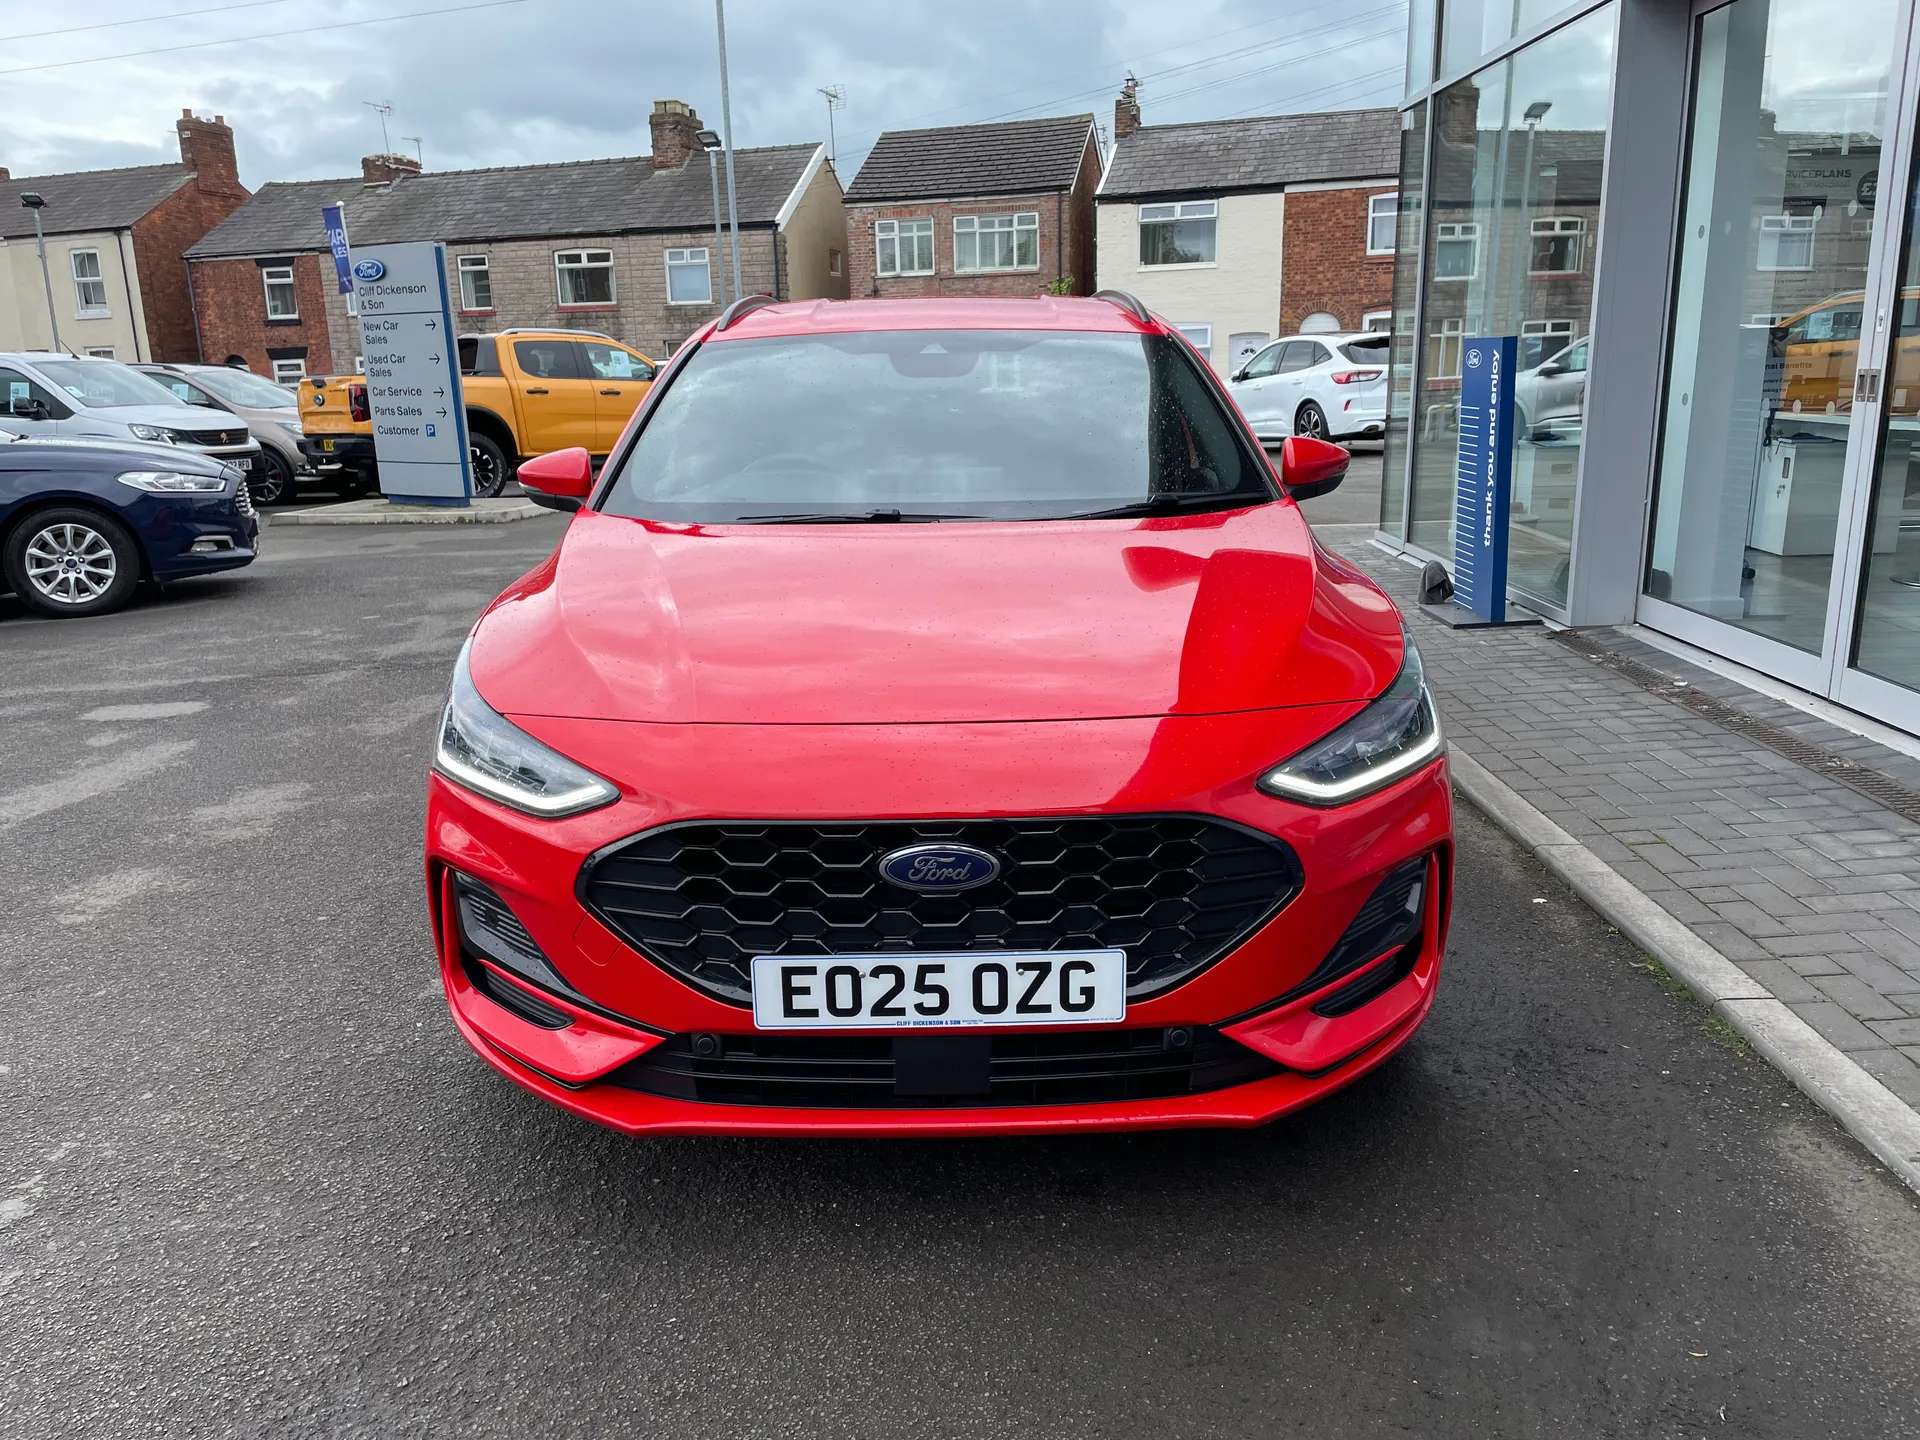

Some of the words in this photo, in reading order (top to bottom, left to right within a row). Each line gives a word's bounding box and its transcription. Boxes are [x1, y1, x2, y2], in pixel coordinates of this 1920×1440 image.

[358, 262, 378, 278] Ford
[359, 286, 375, 297] Cliff
[376, 284, 427, 296] Dickenson
[361, 300, 367, 310] &
[367, 299, 385, 310] Son
[363, 321, 381, 332] New
[382, 320, 399, 331] Car
[365, 334, 388, 345] Sales
[367, 354, 388, 365] Used
[389, 353, 406, 364] Car
[369, 367, 392, 378] Sales
[1490, 349, 1499, 405] enjoy
[372, 386, 387, 397] Car
[387, 386, 422, 397] Service
[374, 406, 396, 416] Parts
[396, 406, 423, 416] Sales
[377, 425, 420, 436] Customer
[1488, 408, 1497, 448] and
[1487, 450, 1495, 487] you
[1484, 490, 1493, 547] thank
[908, 856, 972, 880] Ford
[781, 963, 950, 1018] EO25
[971, 960, 1096, 1015] OZG
